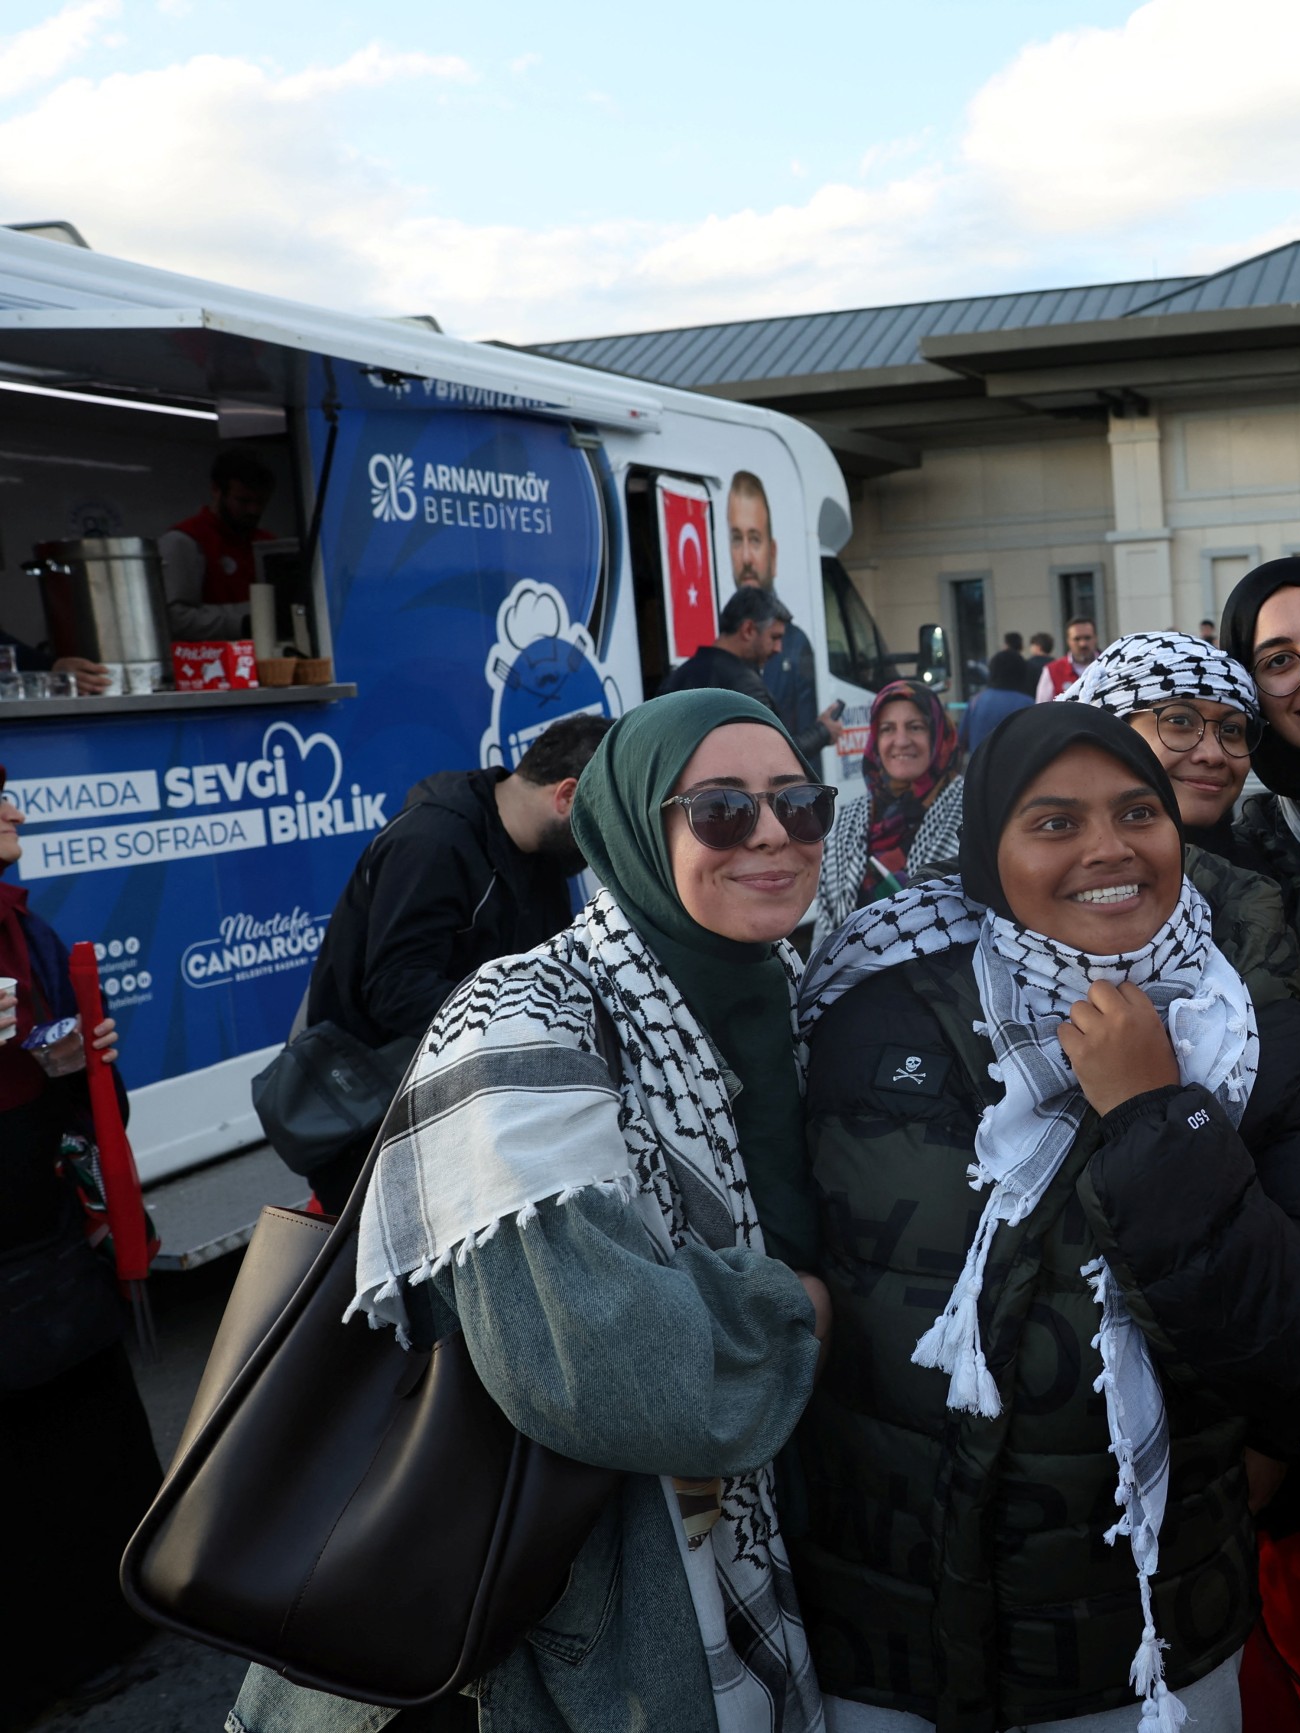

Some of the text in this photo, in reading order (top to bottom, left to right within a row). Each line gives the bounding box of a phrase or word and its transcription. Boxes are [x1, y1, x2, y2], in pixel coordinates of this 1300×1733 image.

[423, 463, 550, 503] ARNAVUTKÖY
[423, 496, 552, 534] BELEDİYESİ
[165, 745, 289, 808] SEVGİ
[42, 783, 388, 868] HER SOFRADA BİRLİK
[220, 905, 312, 945] Mustafa
